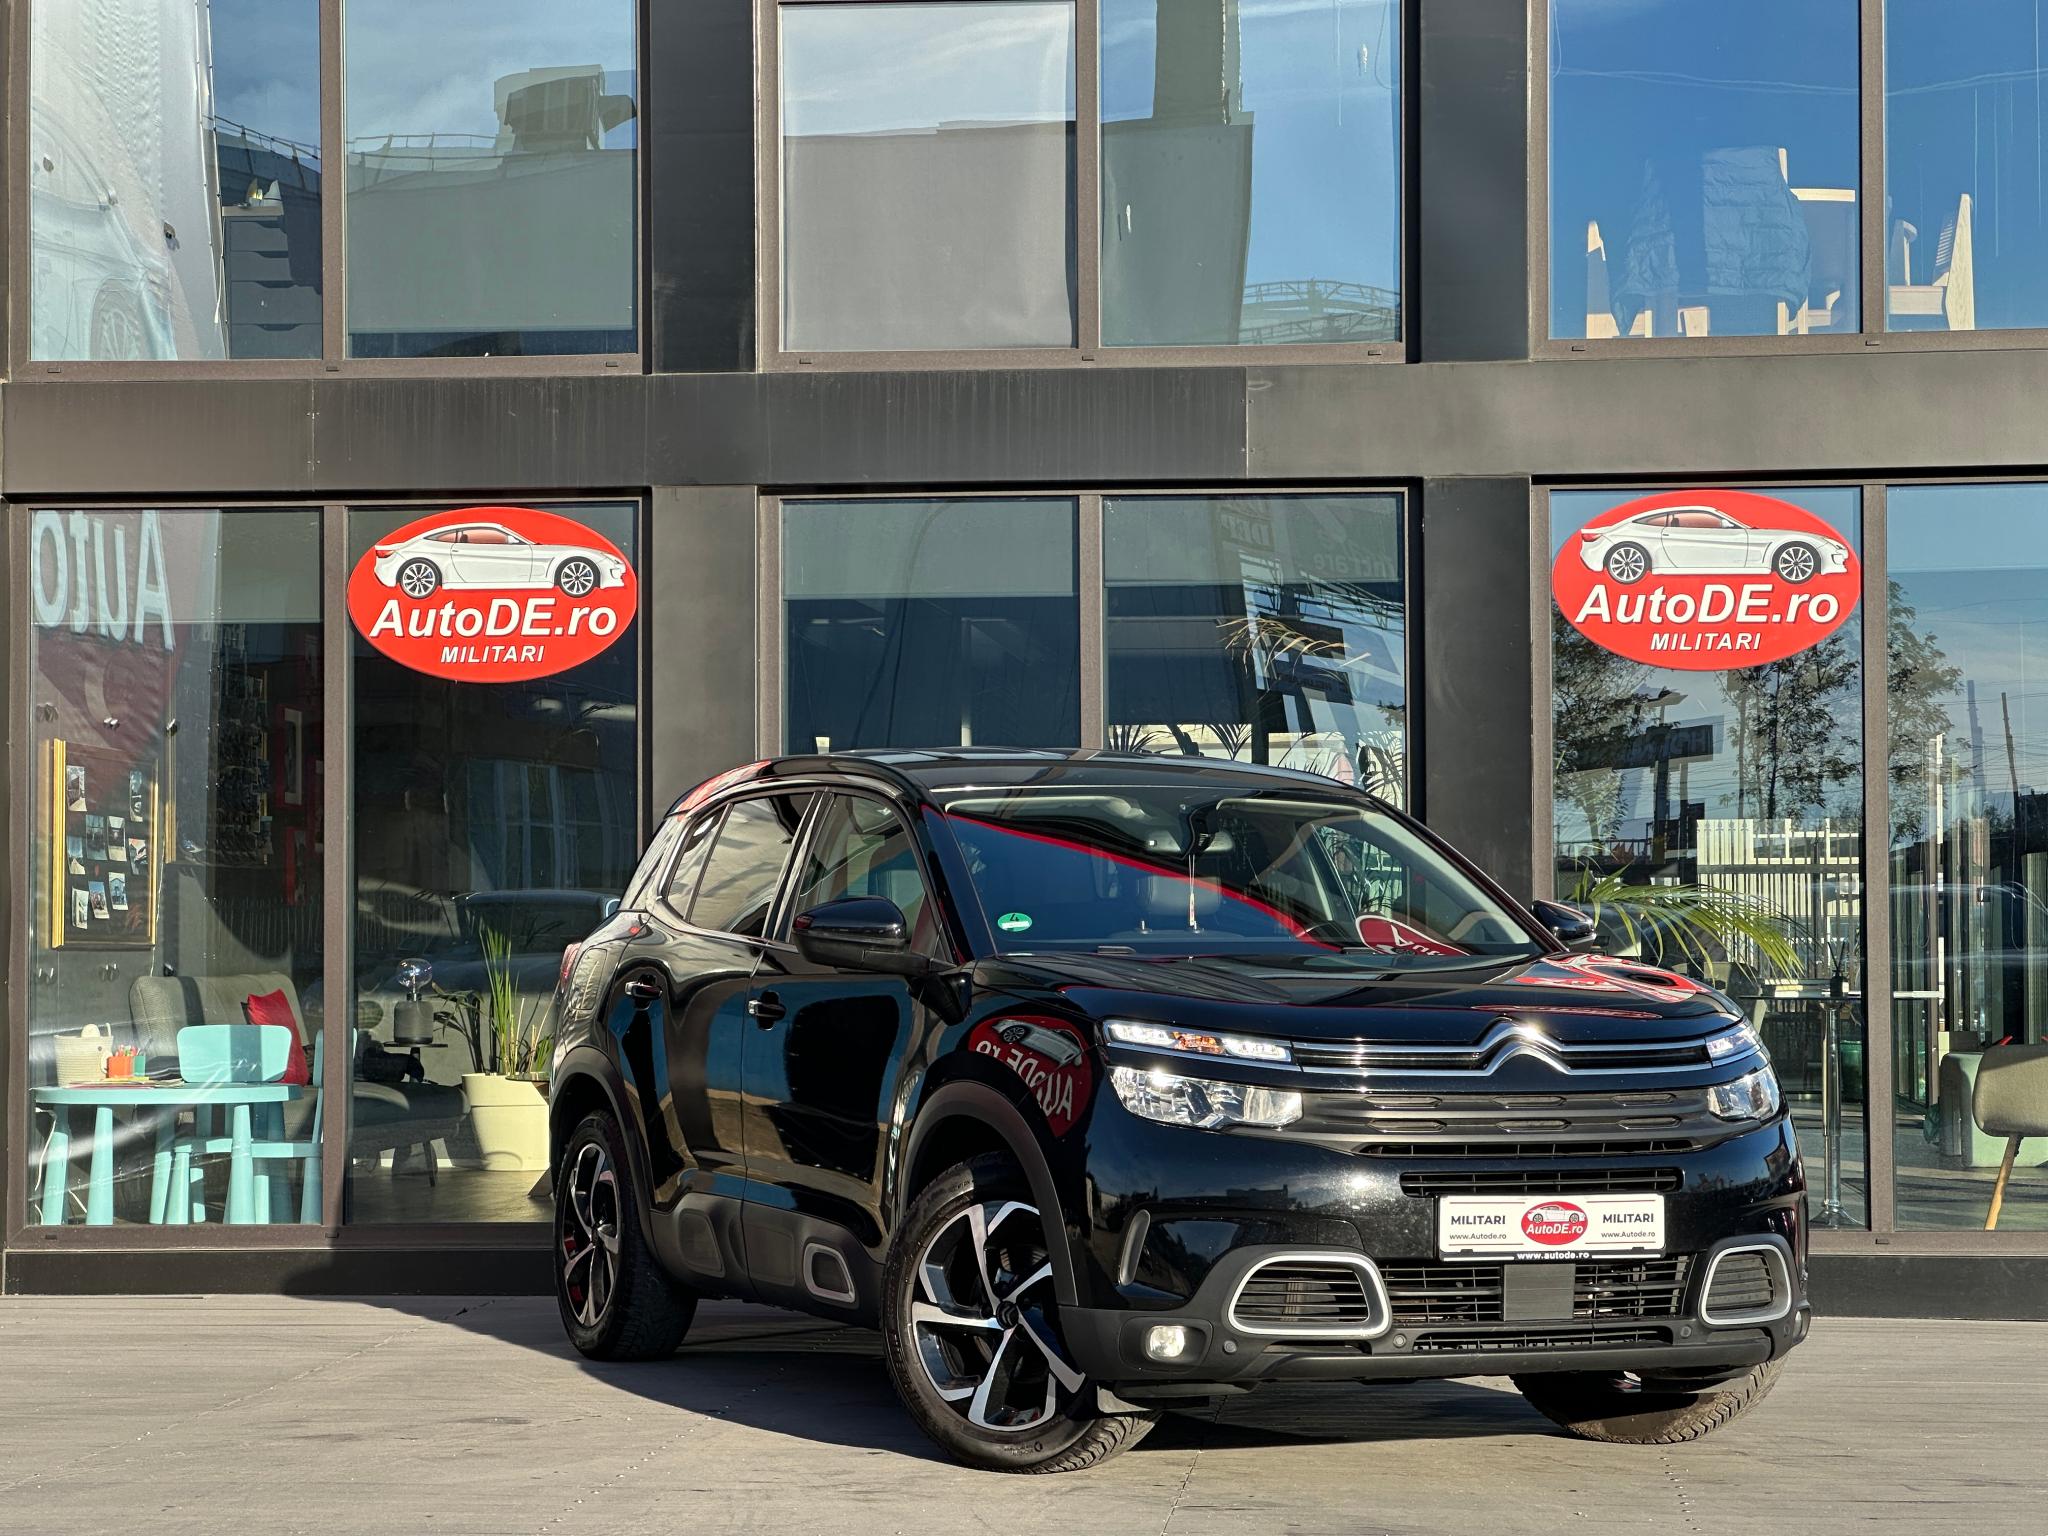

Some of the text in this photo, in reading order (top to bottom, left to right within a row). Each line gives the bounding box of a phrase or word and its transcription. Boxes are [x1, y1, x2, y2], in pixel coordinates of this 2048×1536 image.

[1575, 583, 1840, 624] AutoDE.ro
[369, 597, 618, 639] AutoDE.ro
[1650, 632, 1762, 651] MILITARI
[440, 645, 545, 664] MILITARI
[1450, 1215, 1506, 1225] MILITARI
[1602, 1213, 1655, 1223] MILITARI
[1526, 1223, 1584, 1235] AutoDE.ro
[1516, 1251, 1590, 1260] www.autode.ro
